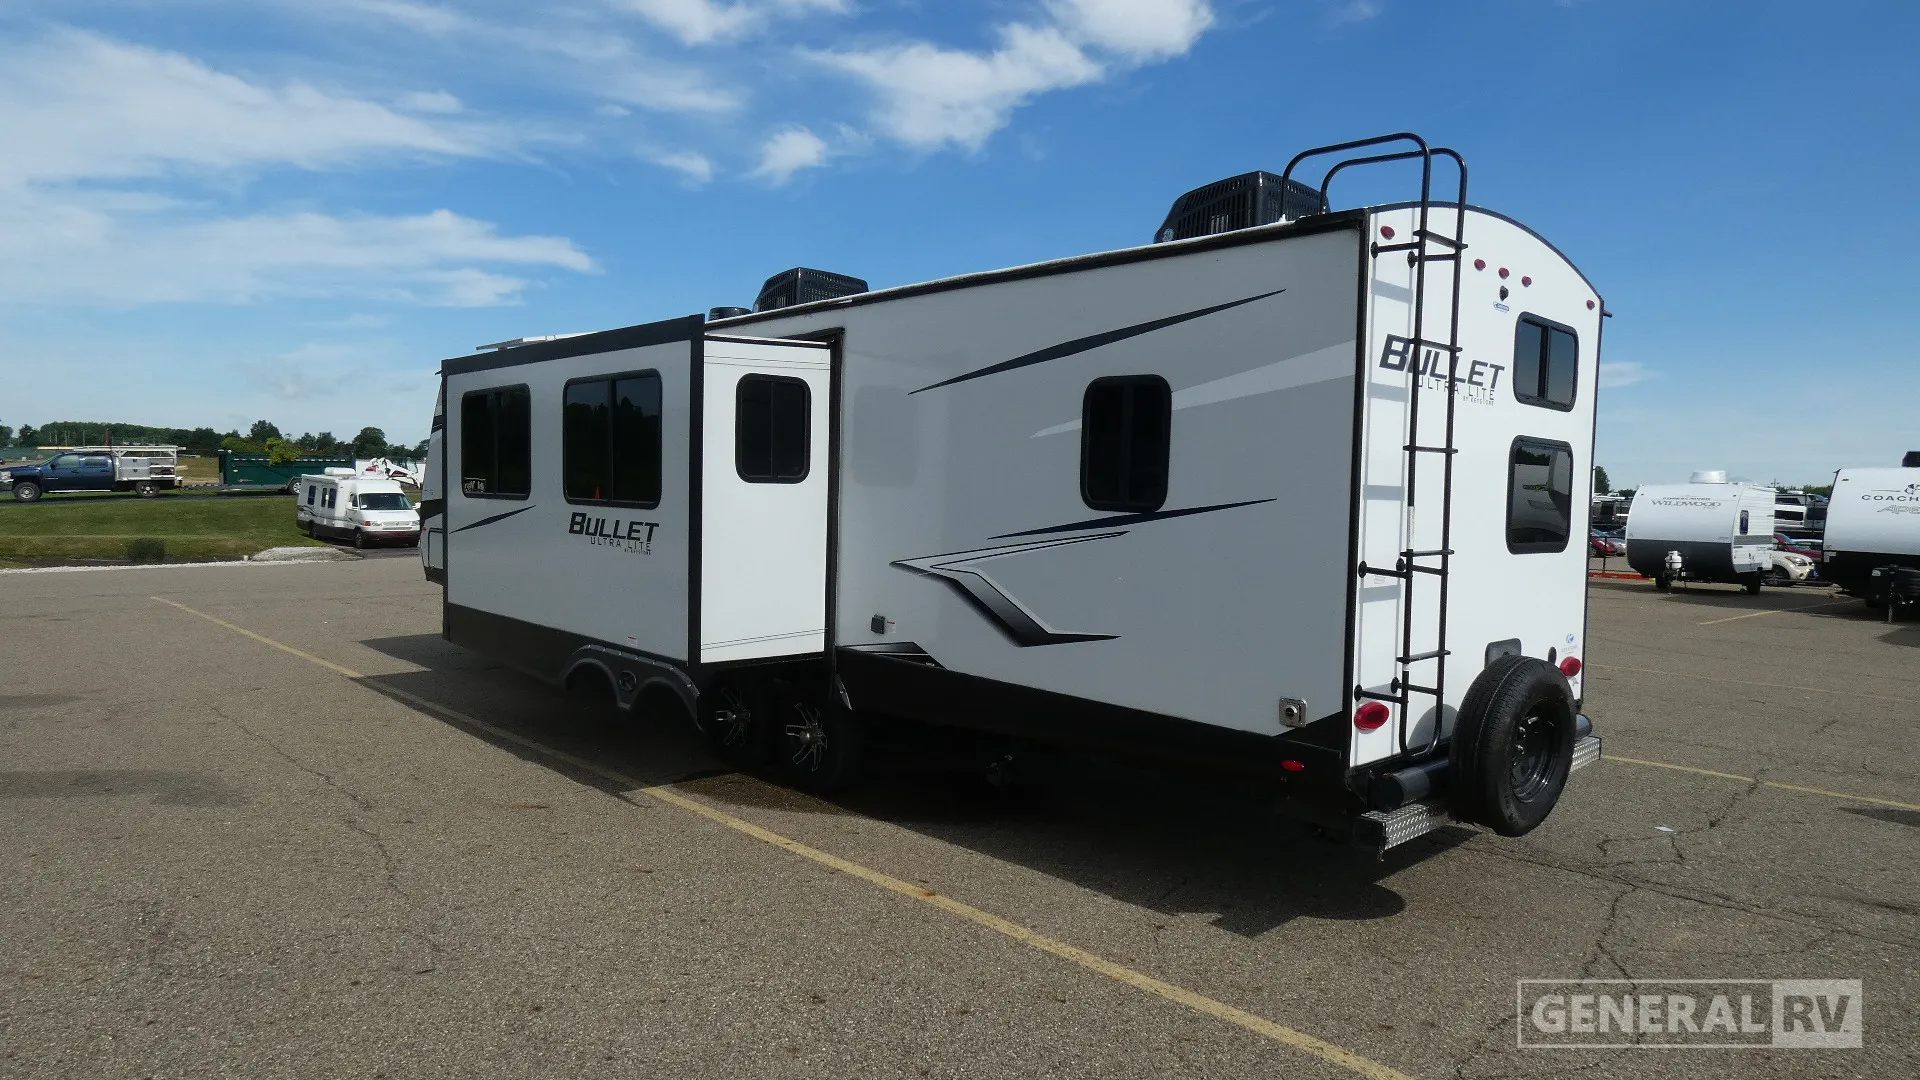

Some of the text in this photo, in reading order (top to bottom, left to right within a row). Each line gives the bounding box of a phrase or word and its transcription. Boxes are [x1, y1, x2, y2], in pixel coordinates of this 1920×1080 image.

[1379, 334, 1505, 389] BULLET
[1468, 385, 1495, 401] LITE
[569, 512, 660, 543] BULLET
[591, 537, 651, 552] ULTRA LITE
